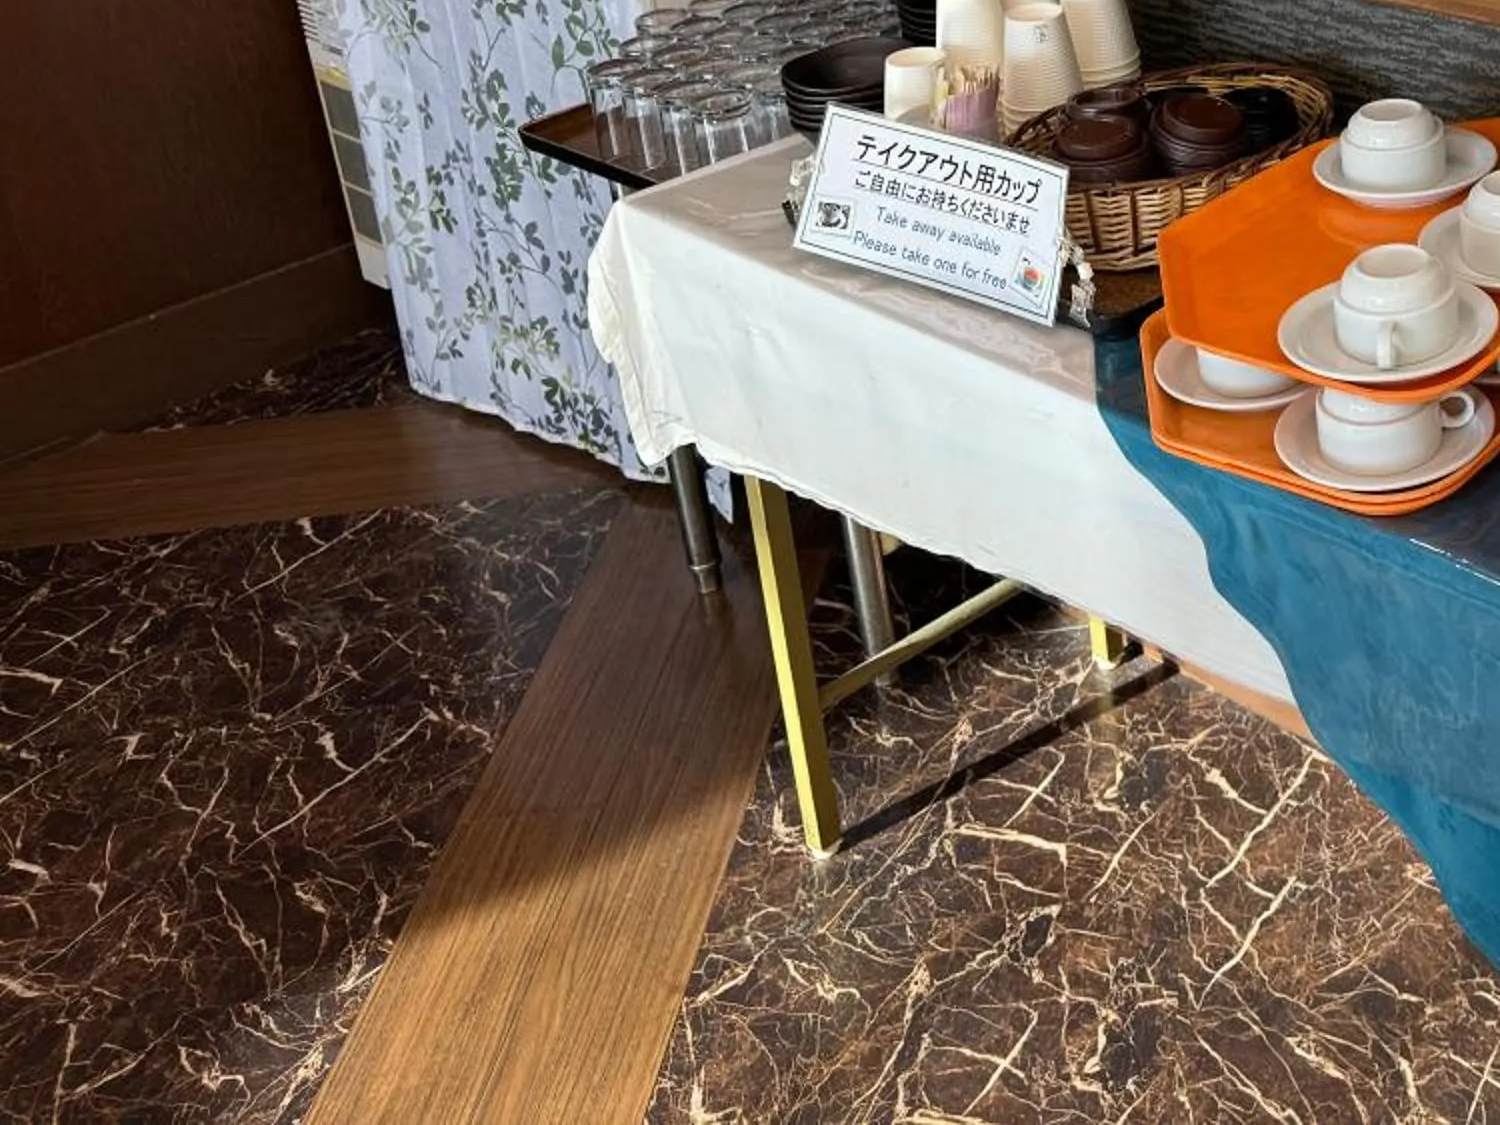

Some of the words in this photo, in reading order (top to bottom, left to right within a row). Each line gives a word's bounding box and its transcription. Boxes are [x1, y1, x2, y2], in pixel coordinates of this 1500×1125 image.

[856, 134, 1043, 205] テイクアウト用カップ
[855, 170, 1031, 236] ご自由にお持ちくださいませ
[876, 205, 908, 228] Take
[911, 219, 945, 243] away
[949, 228, 1002, 256] available
[853, 230, 898, 257] Please
[901, 246, 930, 267] take
[933, 257, 957, 275] one
[961, 259, 981, 282] for
[982, 267, 1008, 290] free
